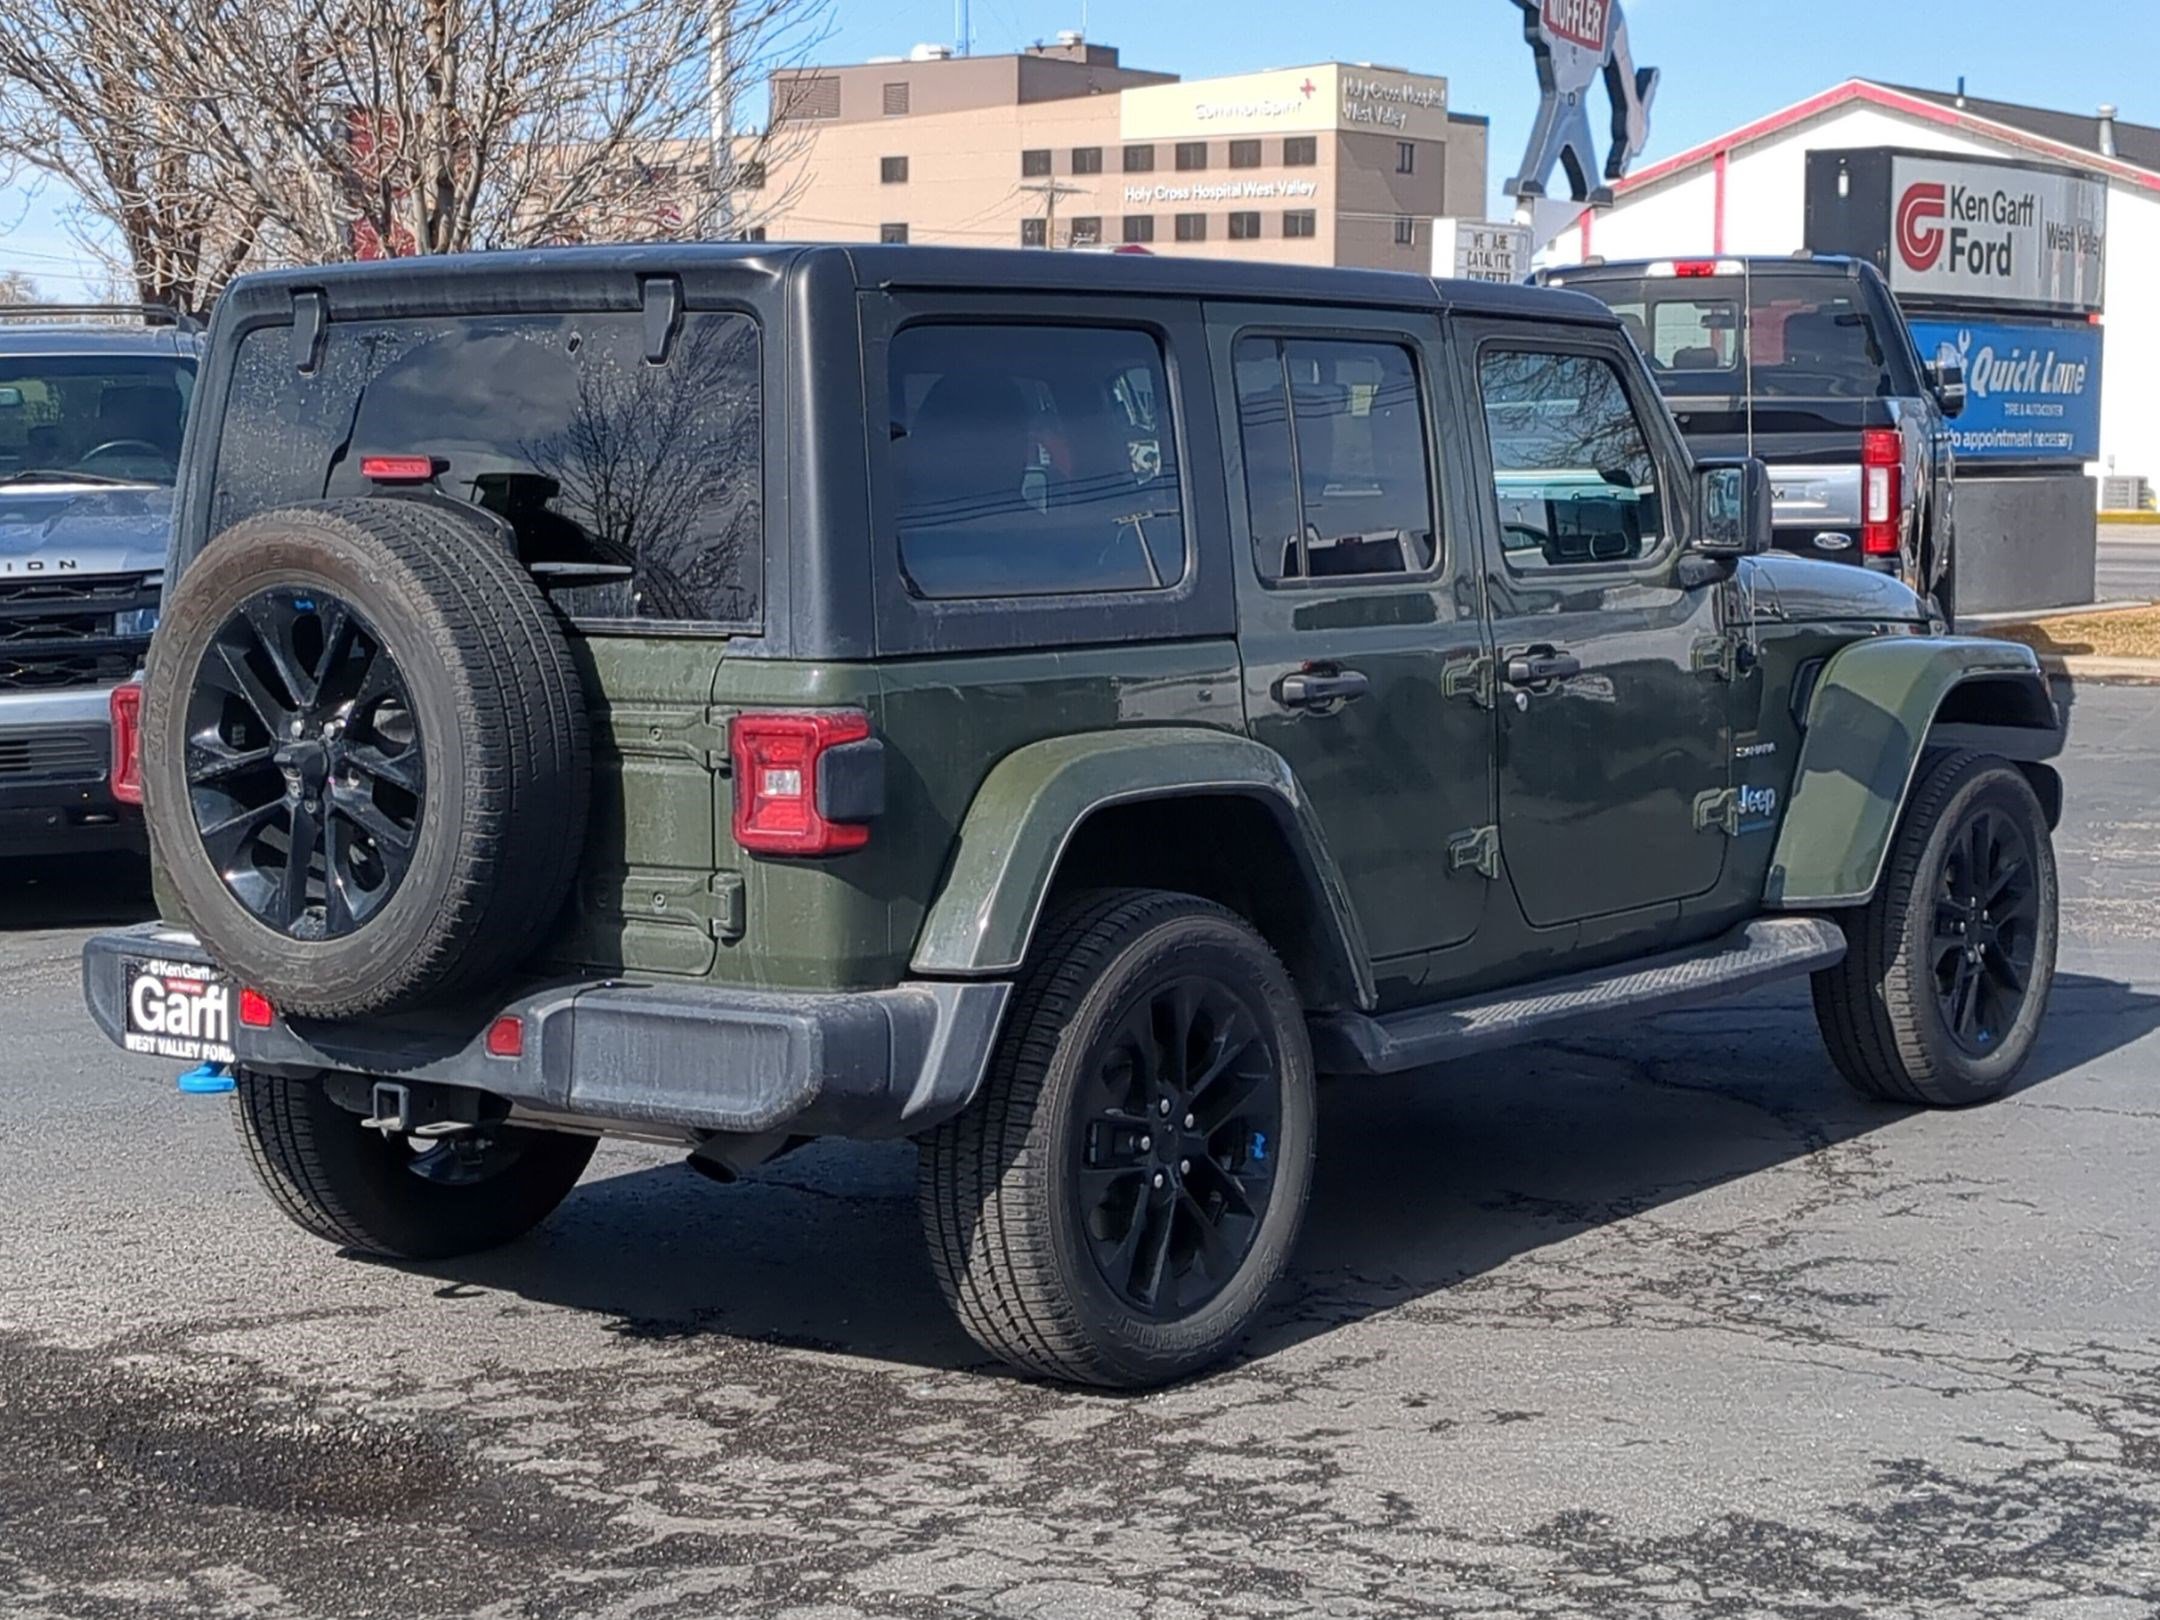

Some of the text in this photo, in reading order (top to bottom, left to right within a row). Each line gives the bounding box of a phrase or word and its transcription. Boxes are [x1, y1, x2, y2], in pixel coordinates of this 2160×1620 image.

[1343, 76, 1446, 109] Holy Cross Hospital
[1343, 101, 1407, 129] West Valley
[1124, 179, 1317, 205] Holy Cross Hospital West Valley
[1950, 184, 2034, 228] Ken Garff
[1493, 232, 1508, 250] ARE
[2046, 220, 2075, 253] West
[1467, 250, 1511, 269] CATALYTIC
[1949, 226, 2012, 277] Ford
[1970, 346, 2085, 398] Quick Lane
[1962, 428, 2033, 451] appointment
[2034, 432, 2074, 451] necessary
[1738, 785, 1776, 816] Jeep
[160, 960, 181, 978] Ken
[131, 975, 229, 1042] Garff
[125, 1032, 157, 1053] WEST
[158, 1037, 201, 1059] VALLEY
